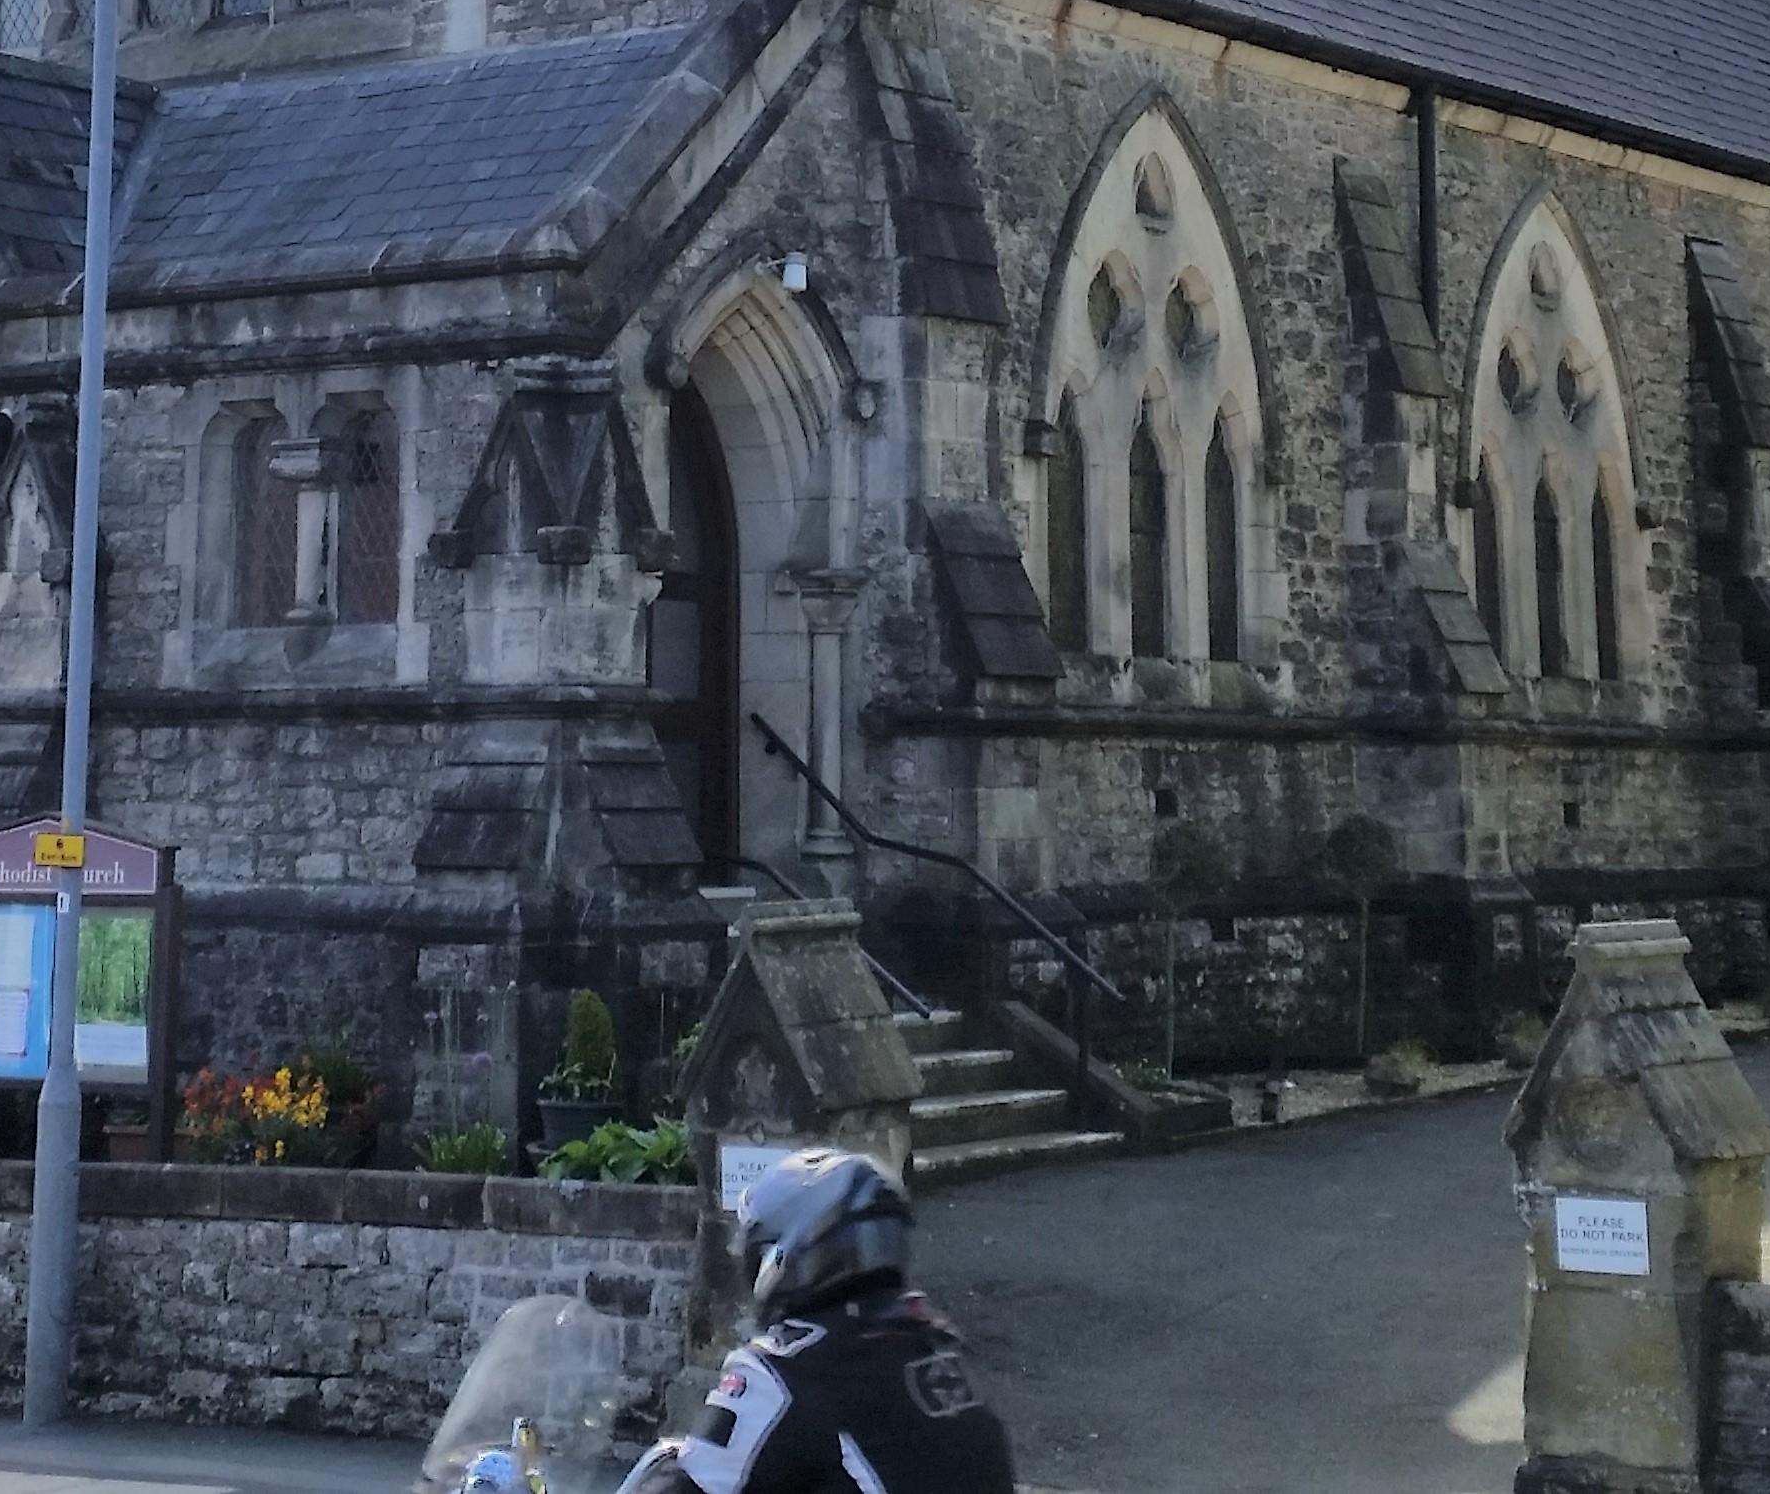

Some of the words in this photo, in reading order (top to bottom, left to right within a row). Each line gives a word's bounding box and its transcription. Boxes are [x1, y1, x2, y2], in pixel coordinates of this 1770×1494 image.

[83, 861, 124, 884] urch
[738, 1162, 768, 1172] PLEA
[1578, 1216, 1624, 1229] PLEASE
[1561, 1228, 1578, 1239] DO
[1583, 1230, 1605, 1241] NOT
[1612, 1231, 1644, 1243] PARK
